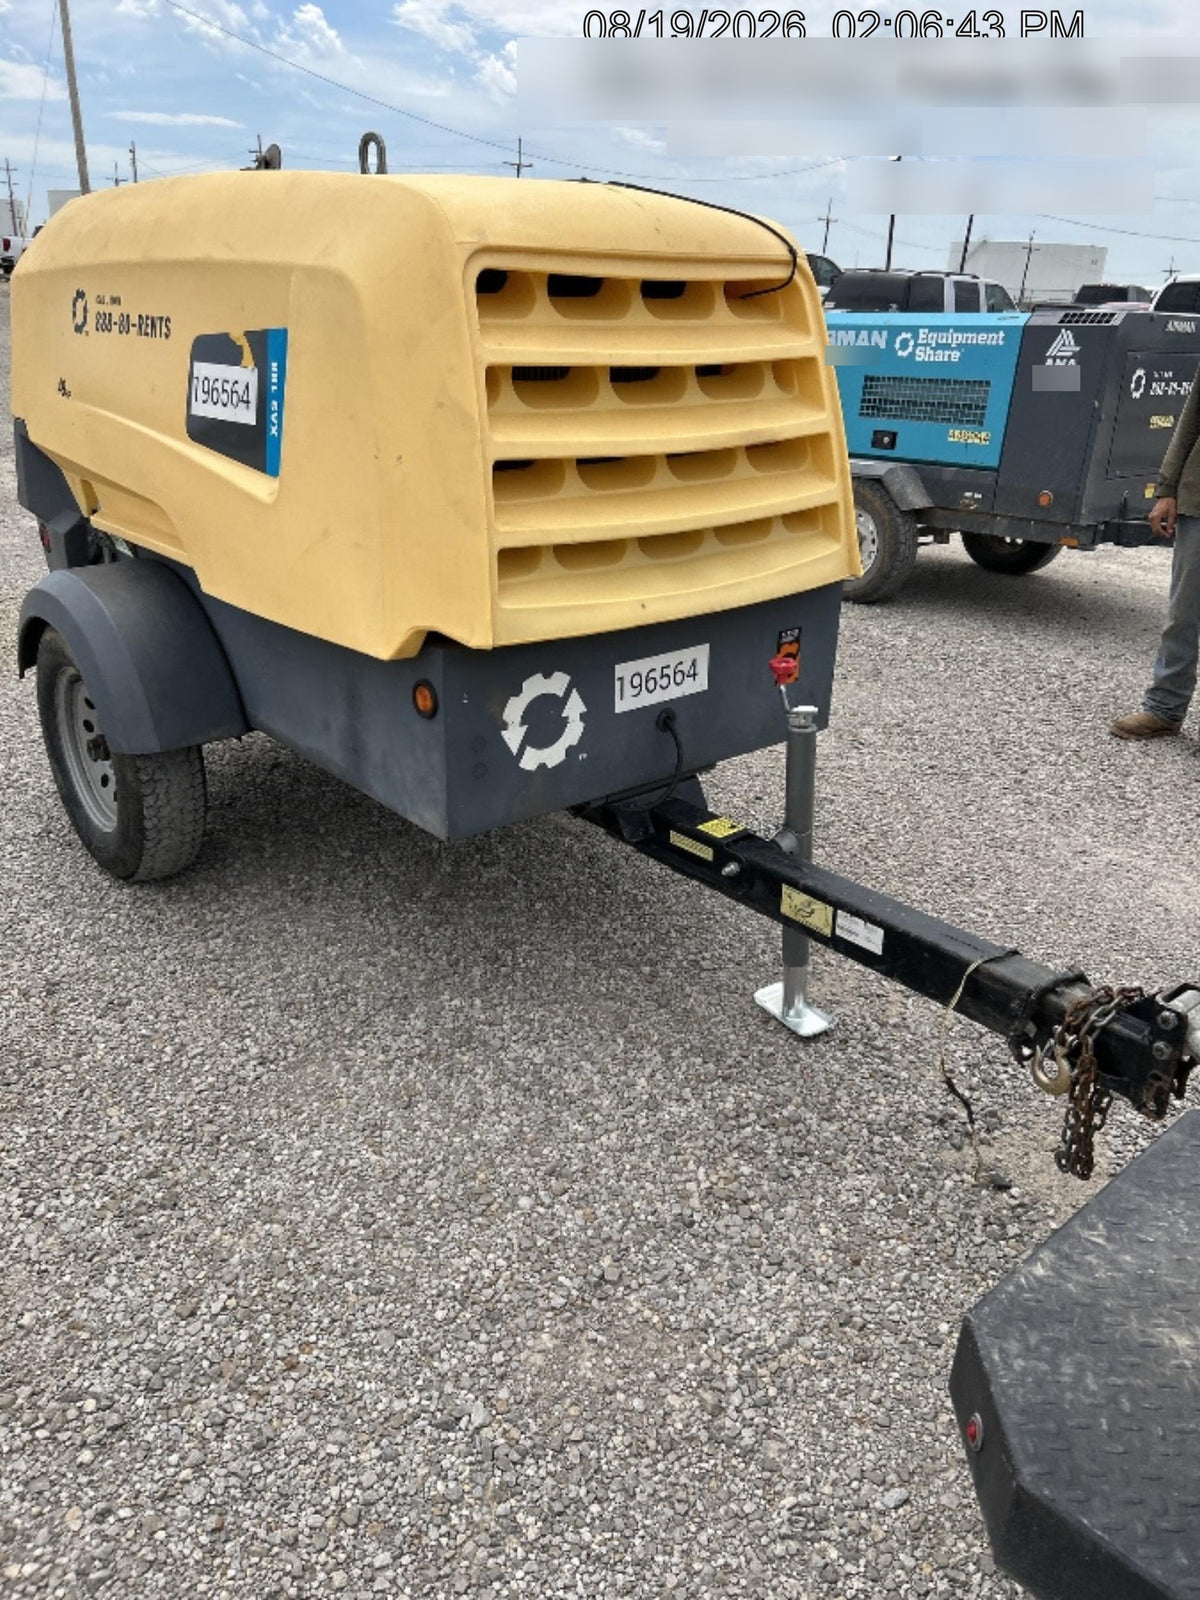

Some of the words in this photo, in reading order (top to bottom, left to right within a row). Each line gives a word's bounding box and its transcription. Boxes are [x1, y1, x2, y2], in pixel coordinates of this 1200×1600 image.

[917, 328, 1005, 346] Equipment
[915, 346, 961, 362] Share
[616, 658, 698, 701] 196564
